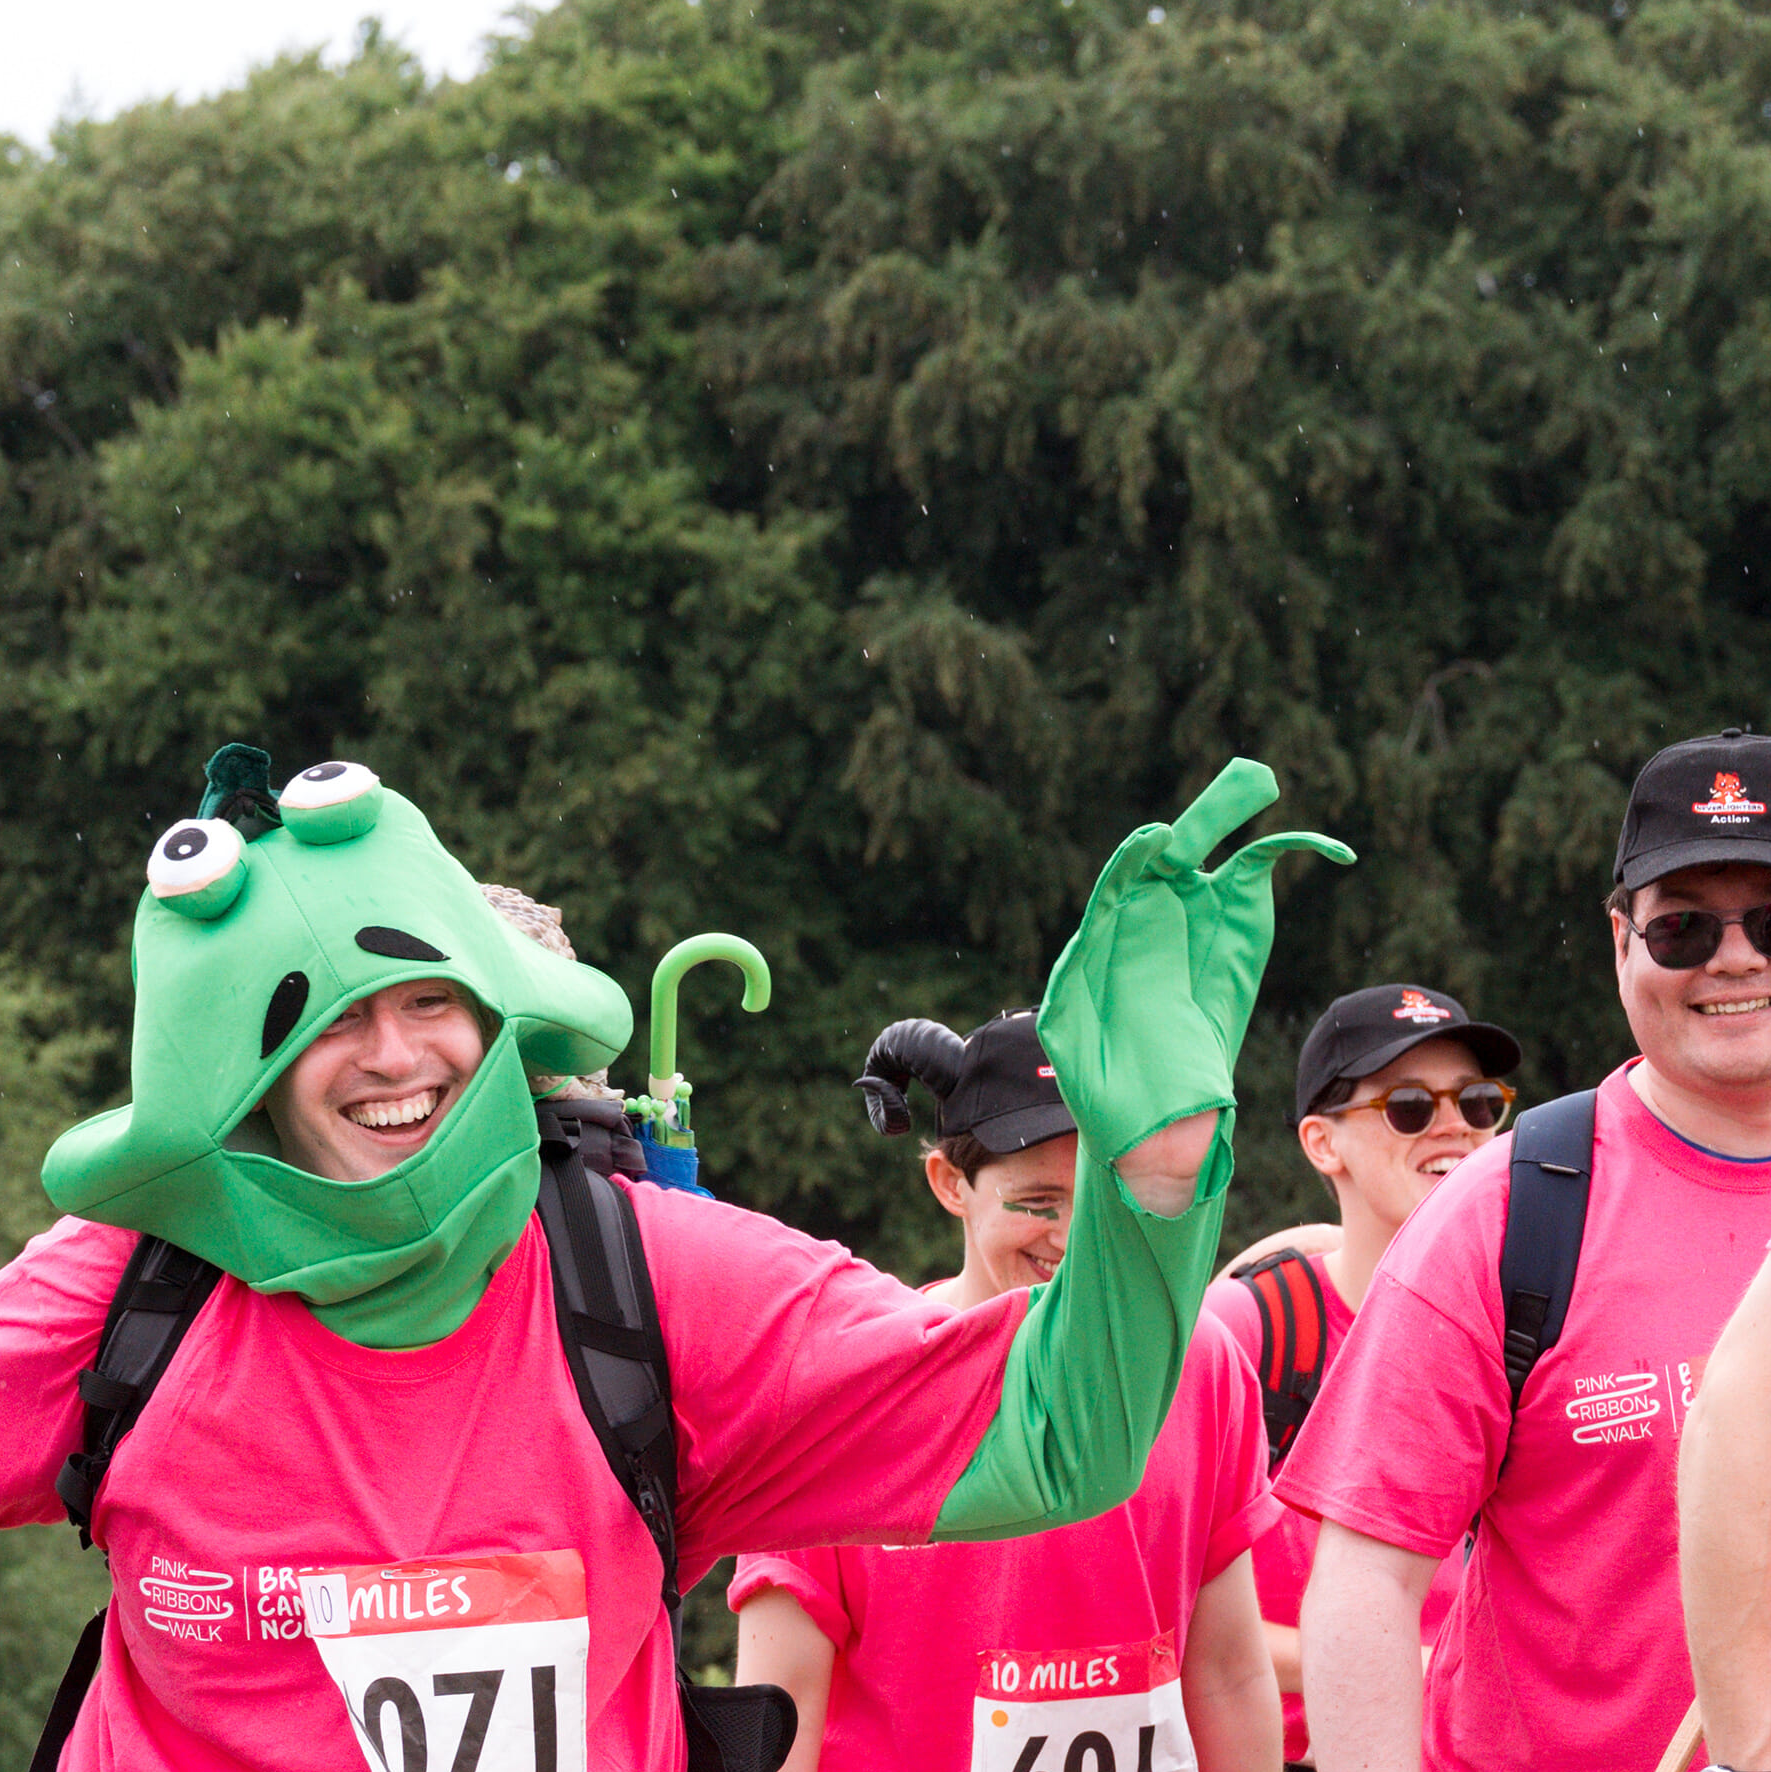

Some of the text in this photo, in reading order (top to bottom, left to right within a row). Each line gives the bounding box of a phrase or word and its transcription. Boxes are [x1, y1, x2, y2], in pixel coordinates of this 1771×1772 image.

[1710, 814, 1751, 824] Action
[1574, 1373, 1616, 1395] PINK
[1579, 1394, 1648, 1421] RIBBON
[1599, 1421, 1652, 1444] WALK
[151, 1556, 189, 1580] PINK
[152, 1586, 221, 1613] RIBBON
[308, 1585, 333, 1625] 10
[349, 1575, 471, 1621] MILES
[168, 1620, 222, 1643] WALK
[990, 1655, 1120, 1693] 10 MILES
